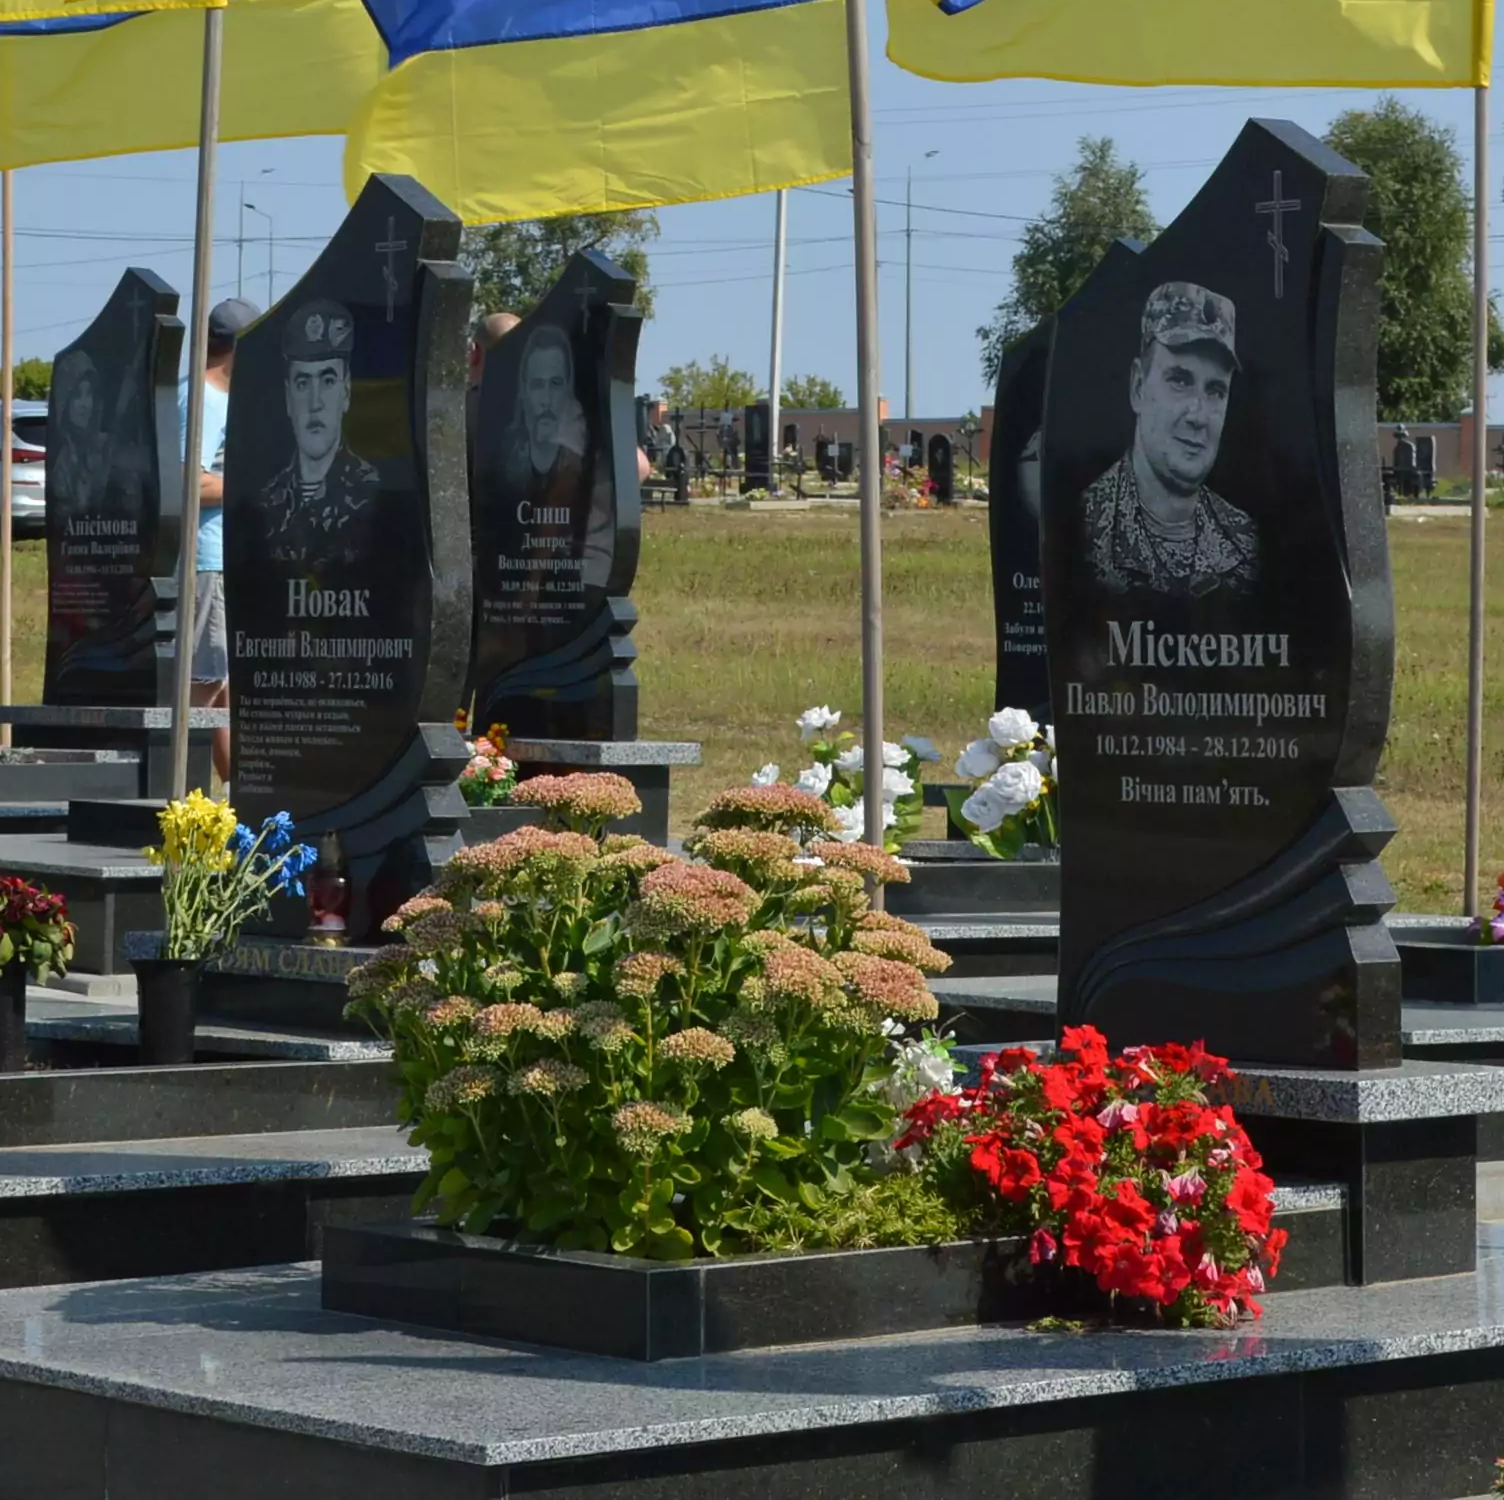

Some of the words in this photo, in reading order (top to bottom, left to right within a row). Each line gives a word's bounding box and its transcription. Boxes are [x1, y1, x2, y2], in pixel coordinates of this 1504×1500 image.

[64, 514, 138, 536] Анісімова
[516, 500, 571, 525] Слиш
[521, 533, 566, 551] Дмитро
[498, 554, 588, 574] Володимирович
[1012, 572, 1041, 590] Оле
[286, 578, 370, 618] Новак
[235, 631, 296, 658] Евгений
[300, 630, 413, 666] Владимирович
[1106, 620, 1291, 668] Міскевич
[253, 671, 317, 688] 02.04.1988
[328, 672, 394, 689] 27.12.2016
[1067, 682, 1135, 717] Павло
[1142, 682, 1327, 727] Володимирович
[1096, 734, 1186, 757] 10.12.1984
[1204, 736, 1299, 759] 28.12.2016
[1120, 776, 1176, 804] Вічна
[1209, 1075, 1274, 1111] АВА
